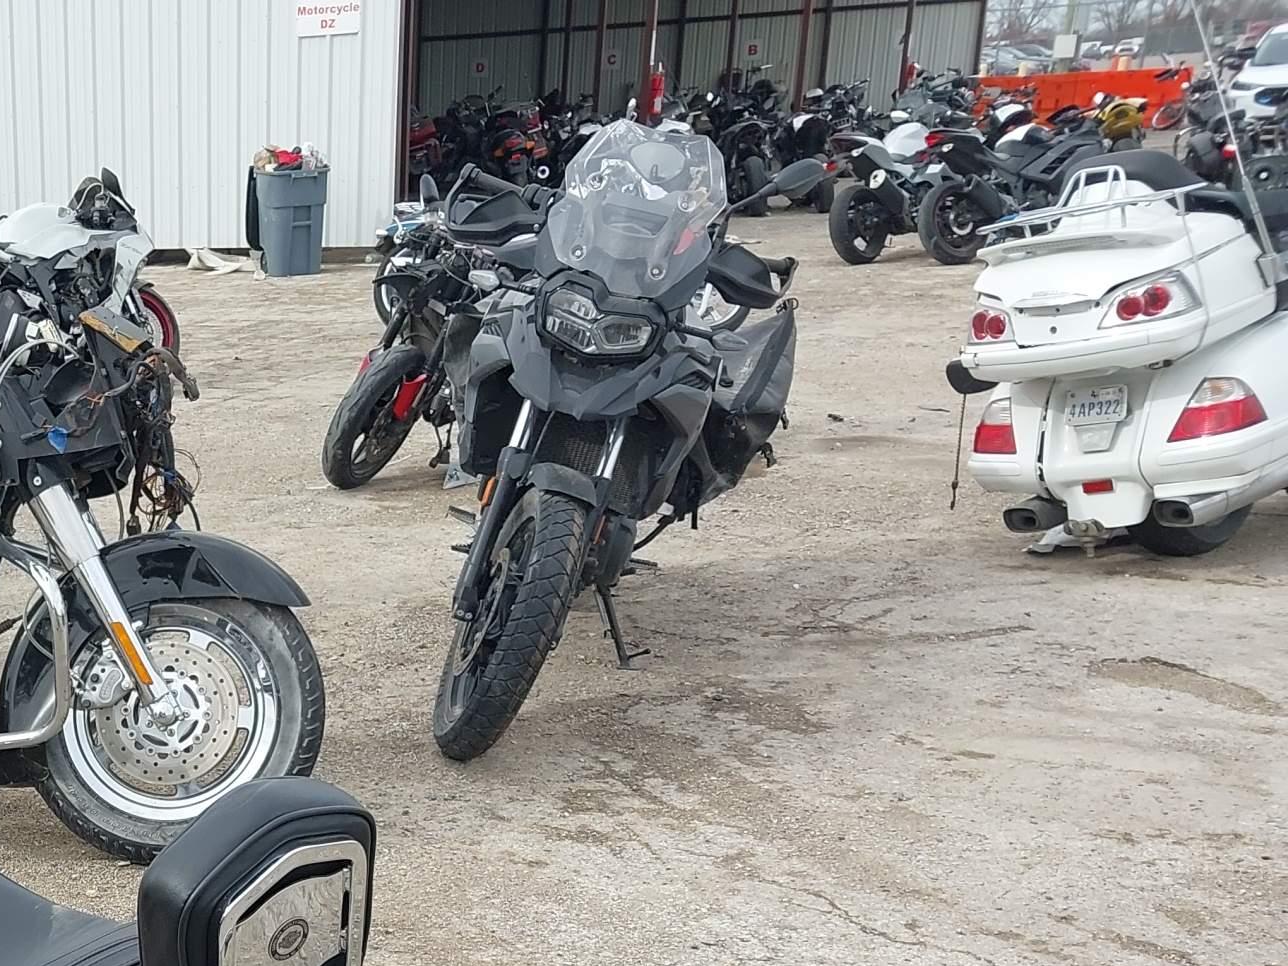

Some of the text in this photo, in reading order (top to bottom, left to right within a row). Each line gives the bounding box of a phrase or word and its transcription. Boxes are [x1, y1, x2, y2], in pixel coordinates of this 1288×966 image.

[297, 2, 360, 16] Motorcycle
[320, 18, 336, 29] DZ
[748, 44, 758, 56] B
[607, 54, 616, 65] C
[476, 62, 484, 73] D
[1070, 399, 1120, 418] 4AP322
